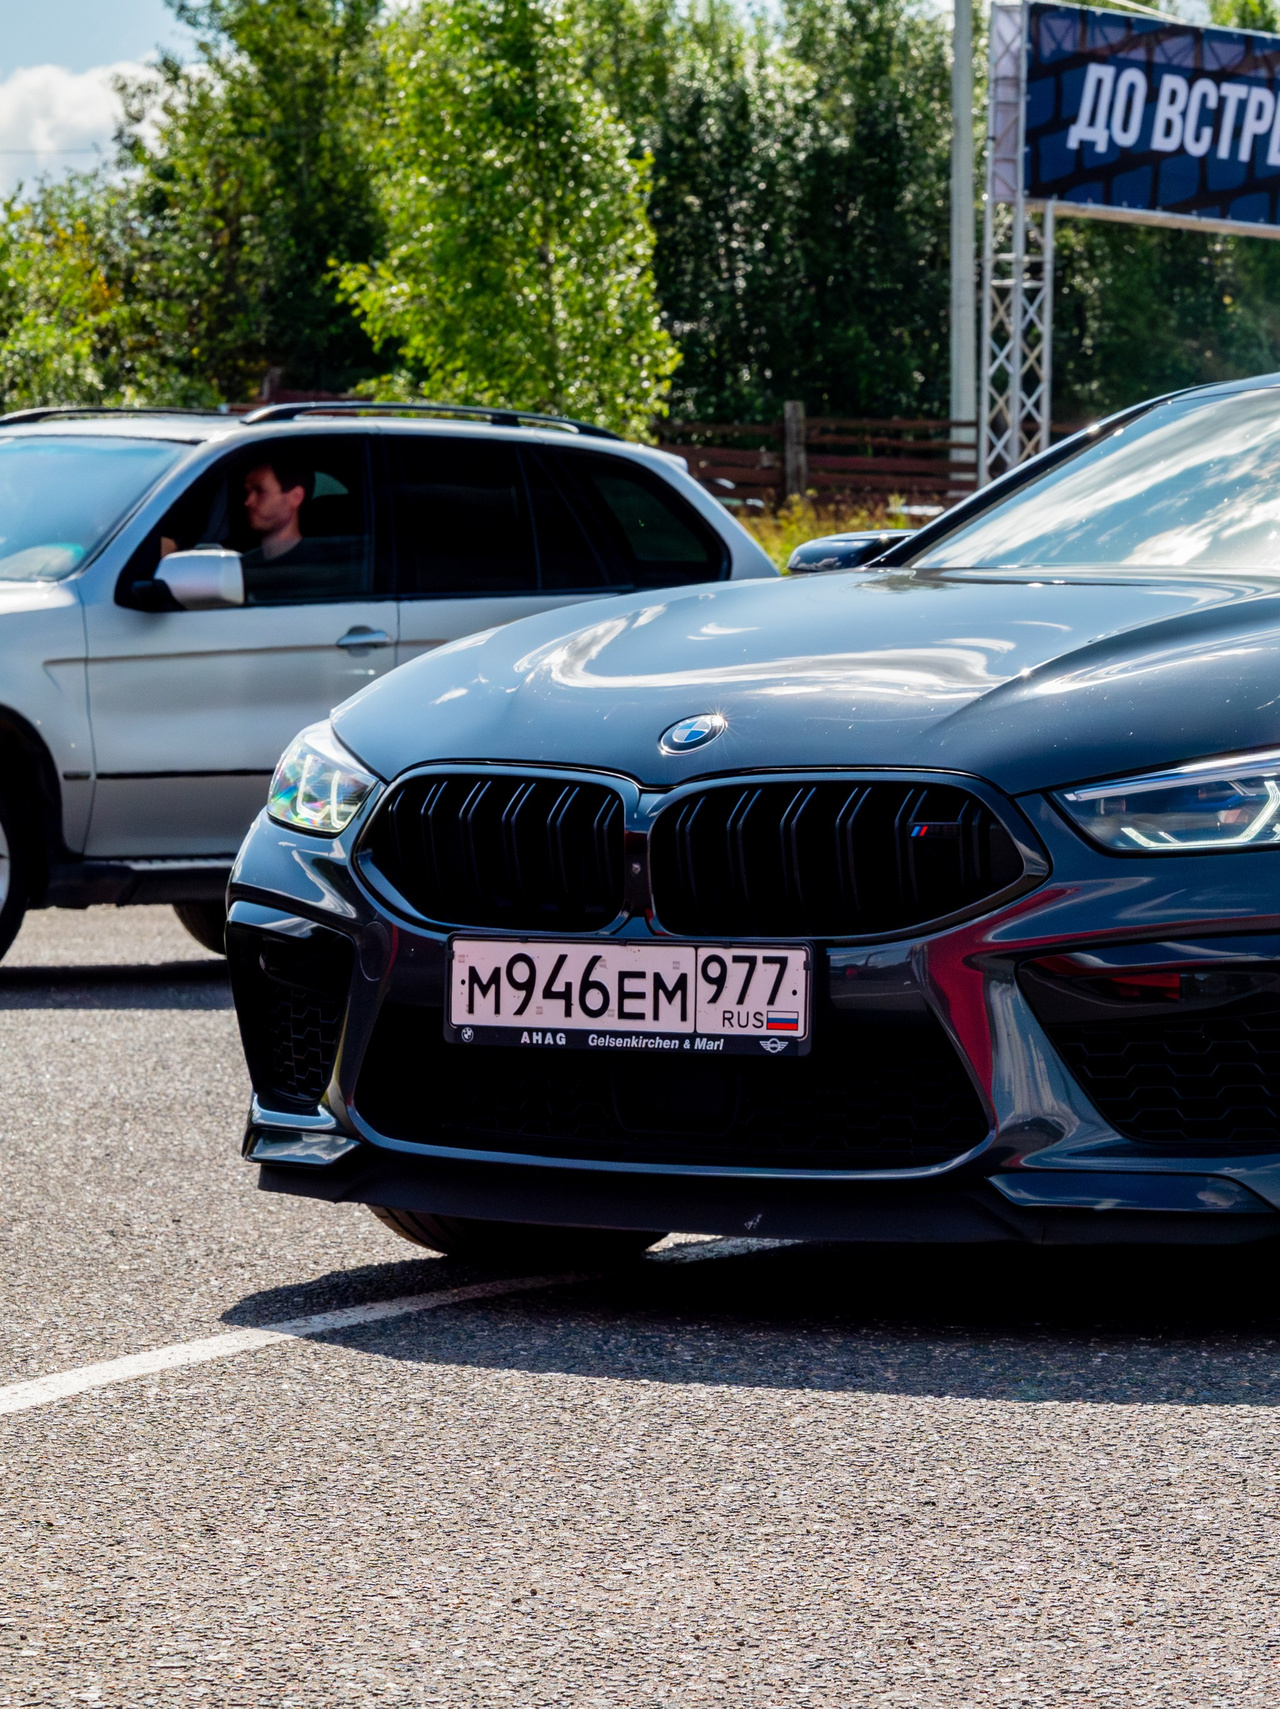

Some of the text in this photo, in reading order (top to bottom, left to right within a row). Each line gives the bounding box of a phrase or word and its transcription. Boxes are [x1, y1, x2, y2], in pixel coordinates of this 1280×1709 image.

[1066, 62, 1148, 153] ДО
[701, 954, 788, 1005] 977
[722, 1010, 764, 1029] RUS
[520, 1031, 724, 1050] AHAG Gelsenkirchen & Marl
